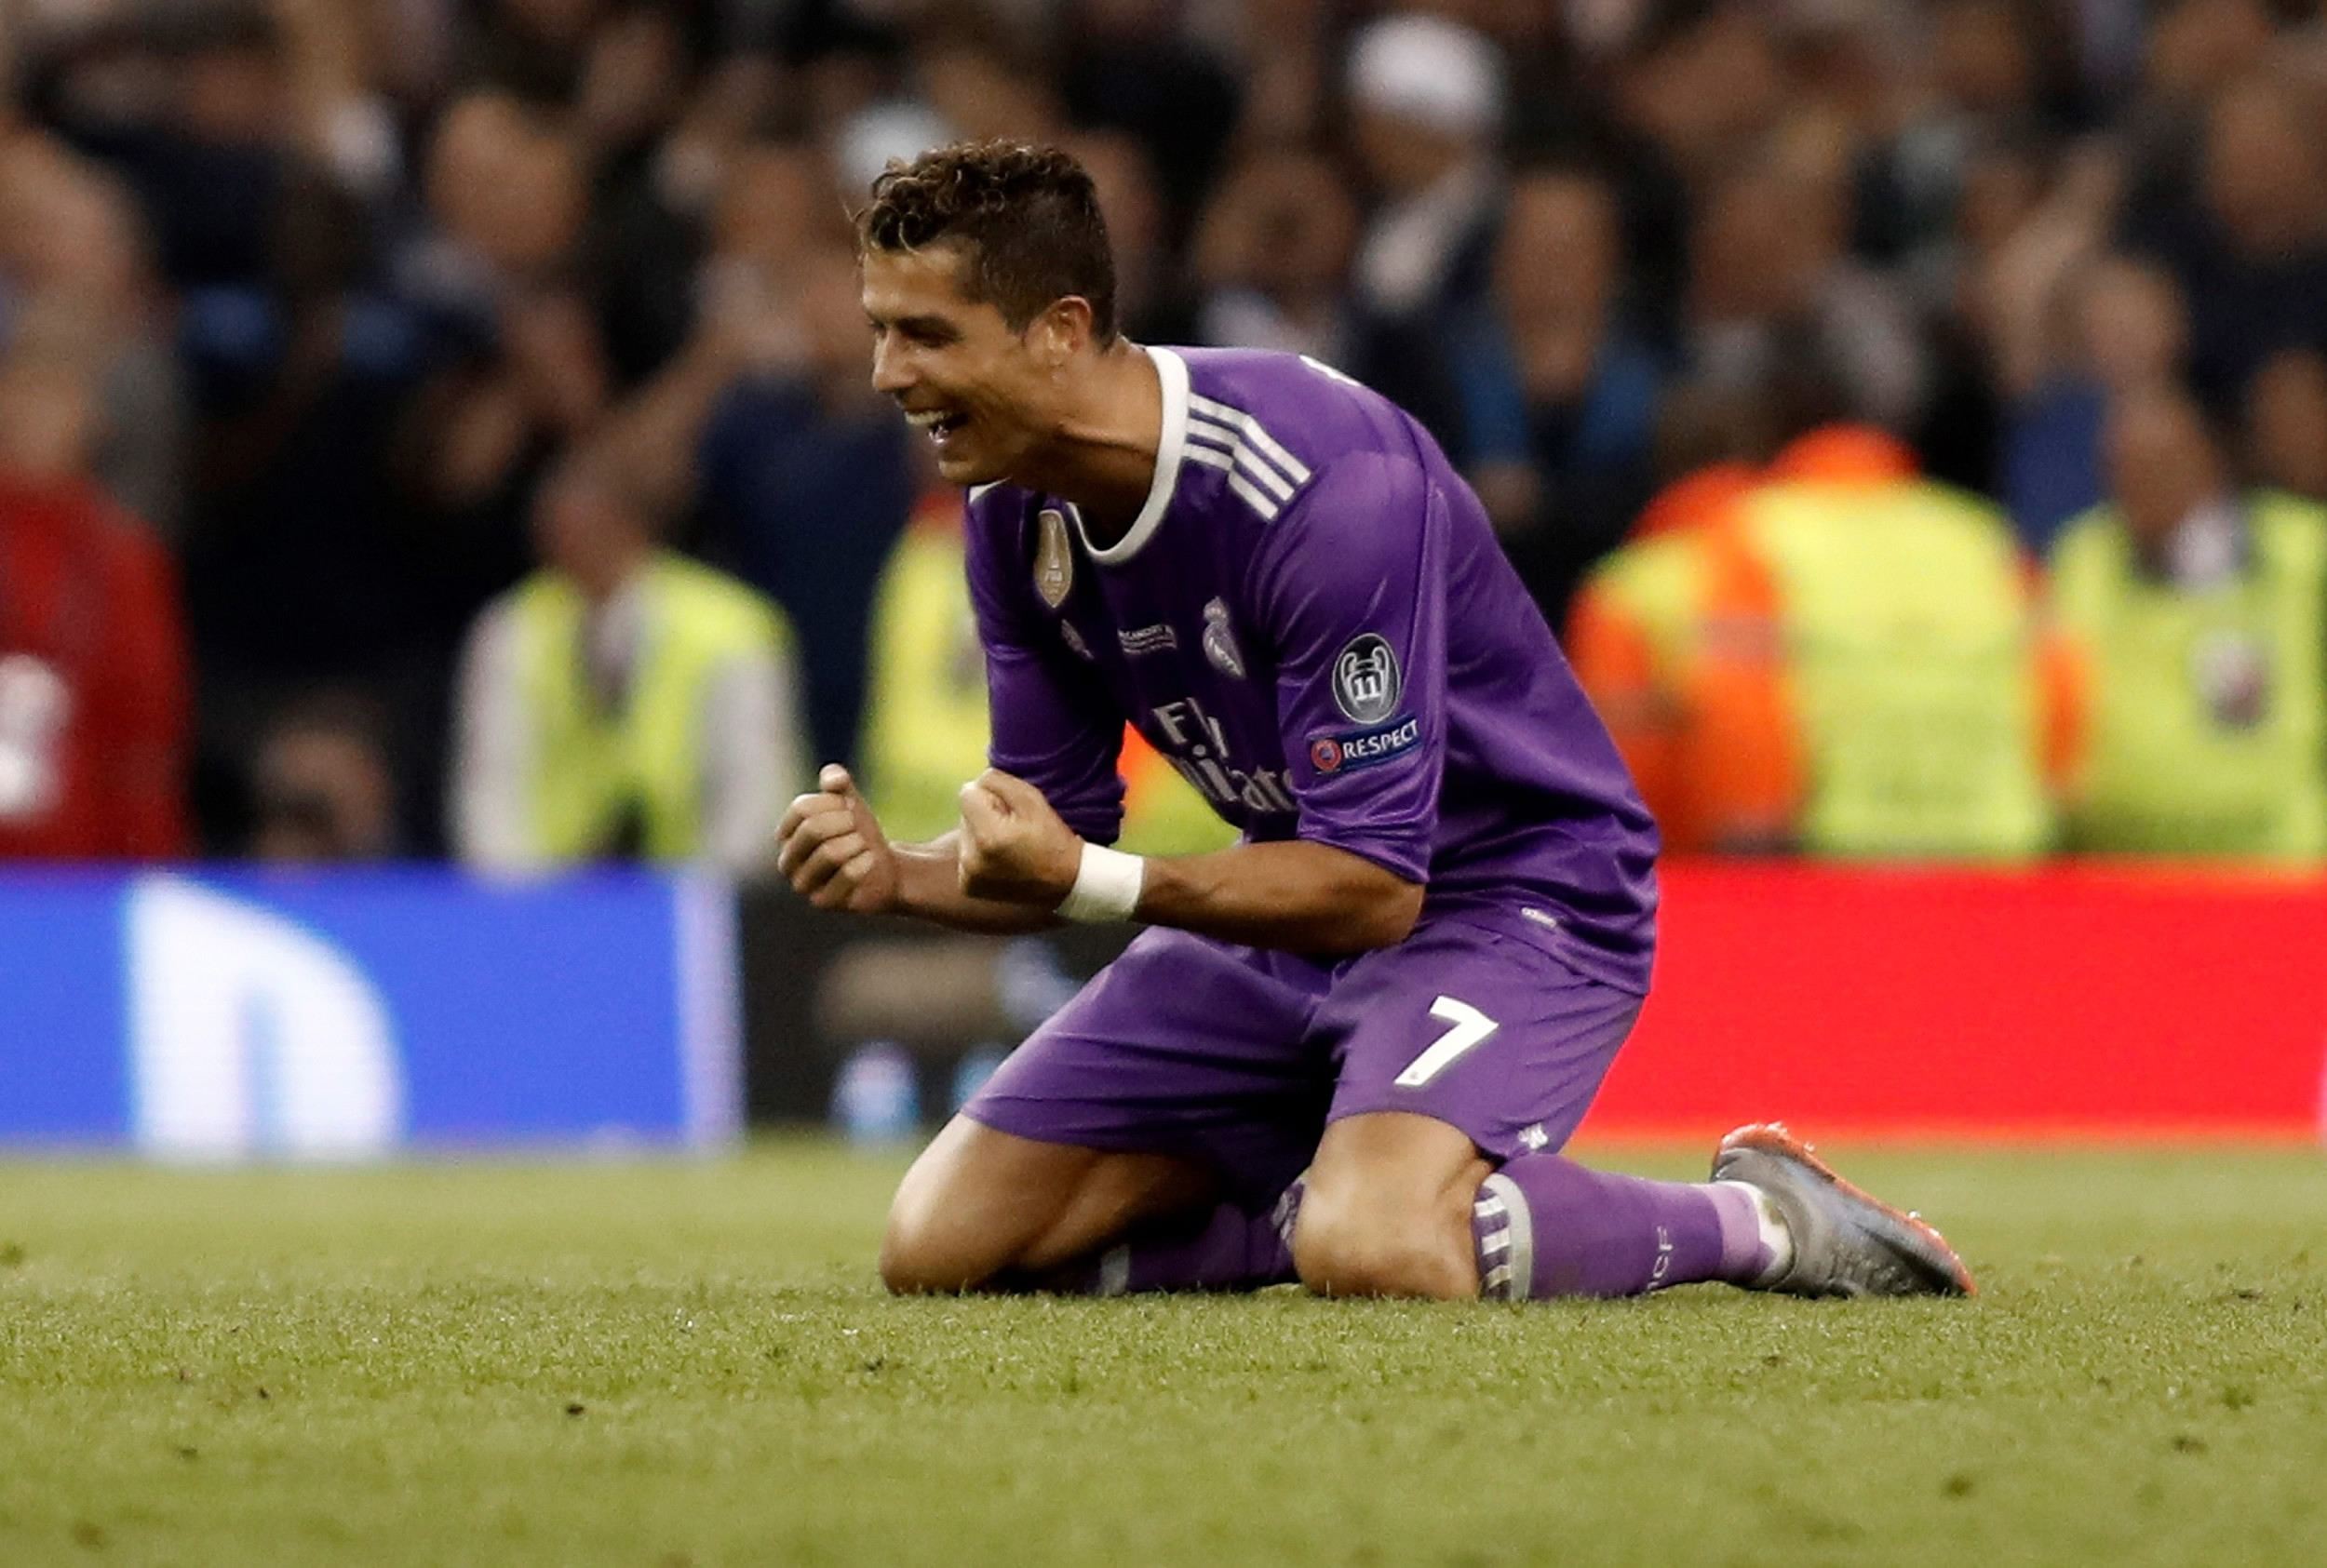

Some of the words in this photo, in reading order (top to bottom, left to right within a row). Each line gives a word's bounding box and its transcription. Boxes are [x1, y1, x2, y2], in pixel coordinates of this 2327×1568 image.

[1353, 676, 1381, 701] 11
[1342, 718, 1419, 759] RESPECT
[1393, 994, 1500, 1087] 7
